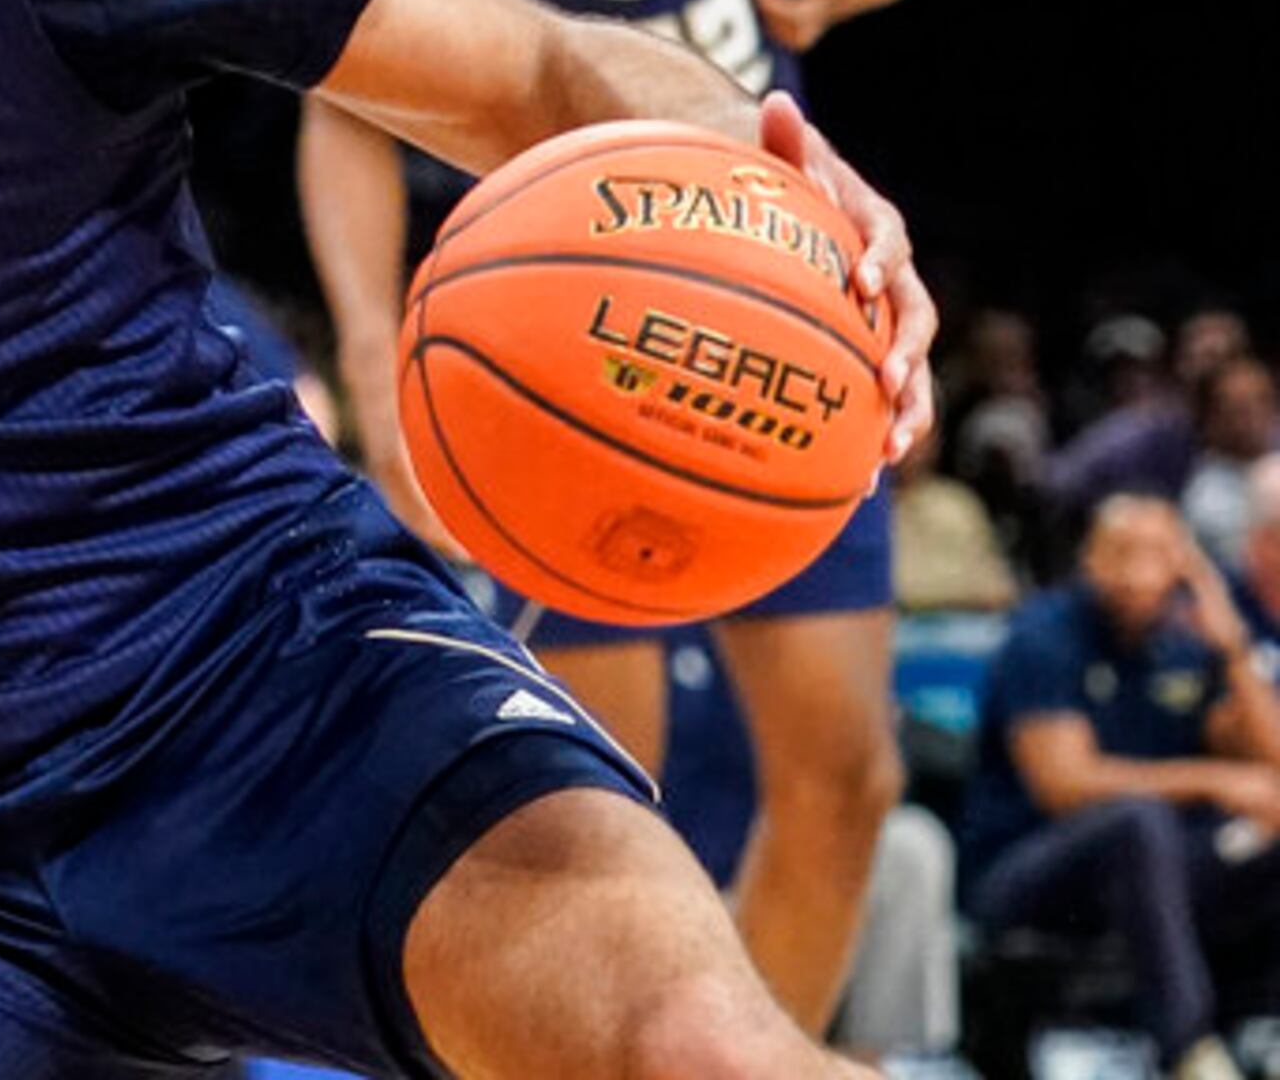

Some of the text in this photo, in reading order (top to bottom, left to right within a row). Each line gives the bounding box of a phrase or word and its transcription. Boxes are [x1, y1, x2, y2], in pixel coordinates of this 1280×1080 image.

[592, 175, 852, 298] SPALDIN
[588, 296, 849, 423] LEGACY
[667, 381, 814, 450] 1000
